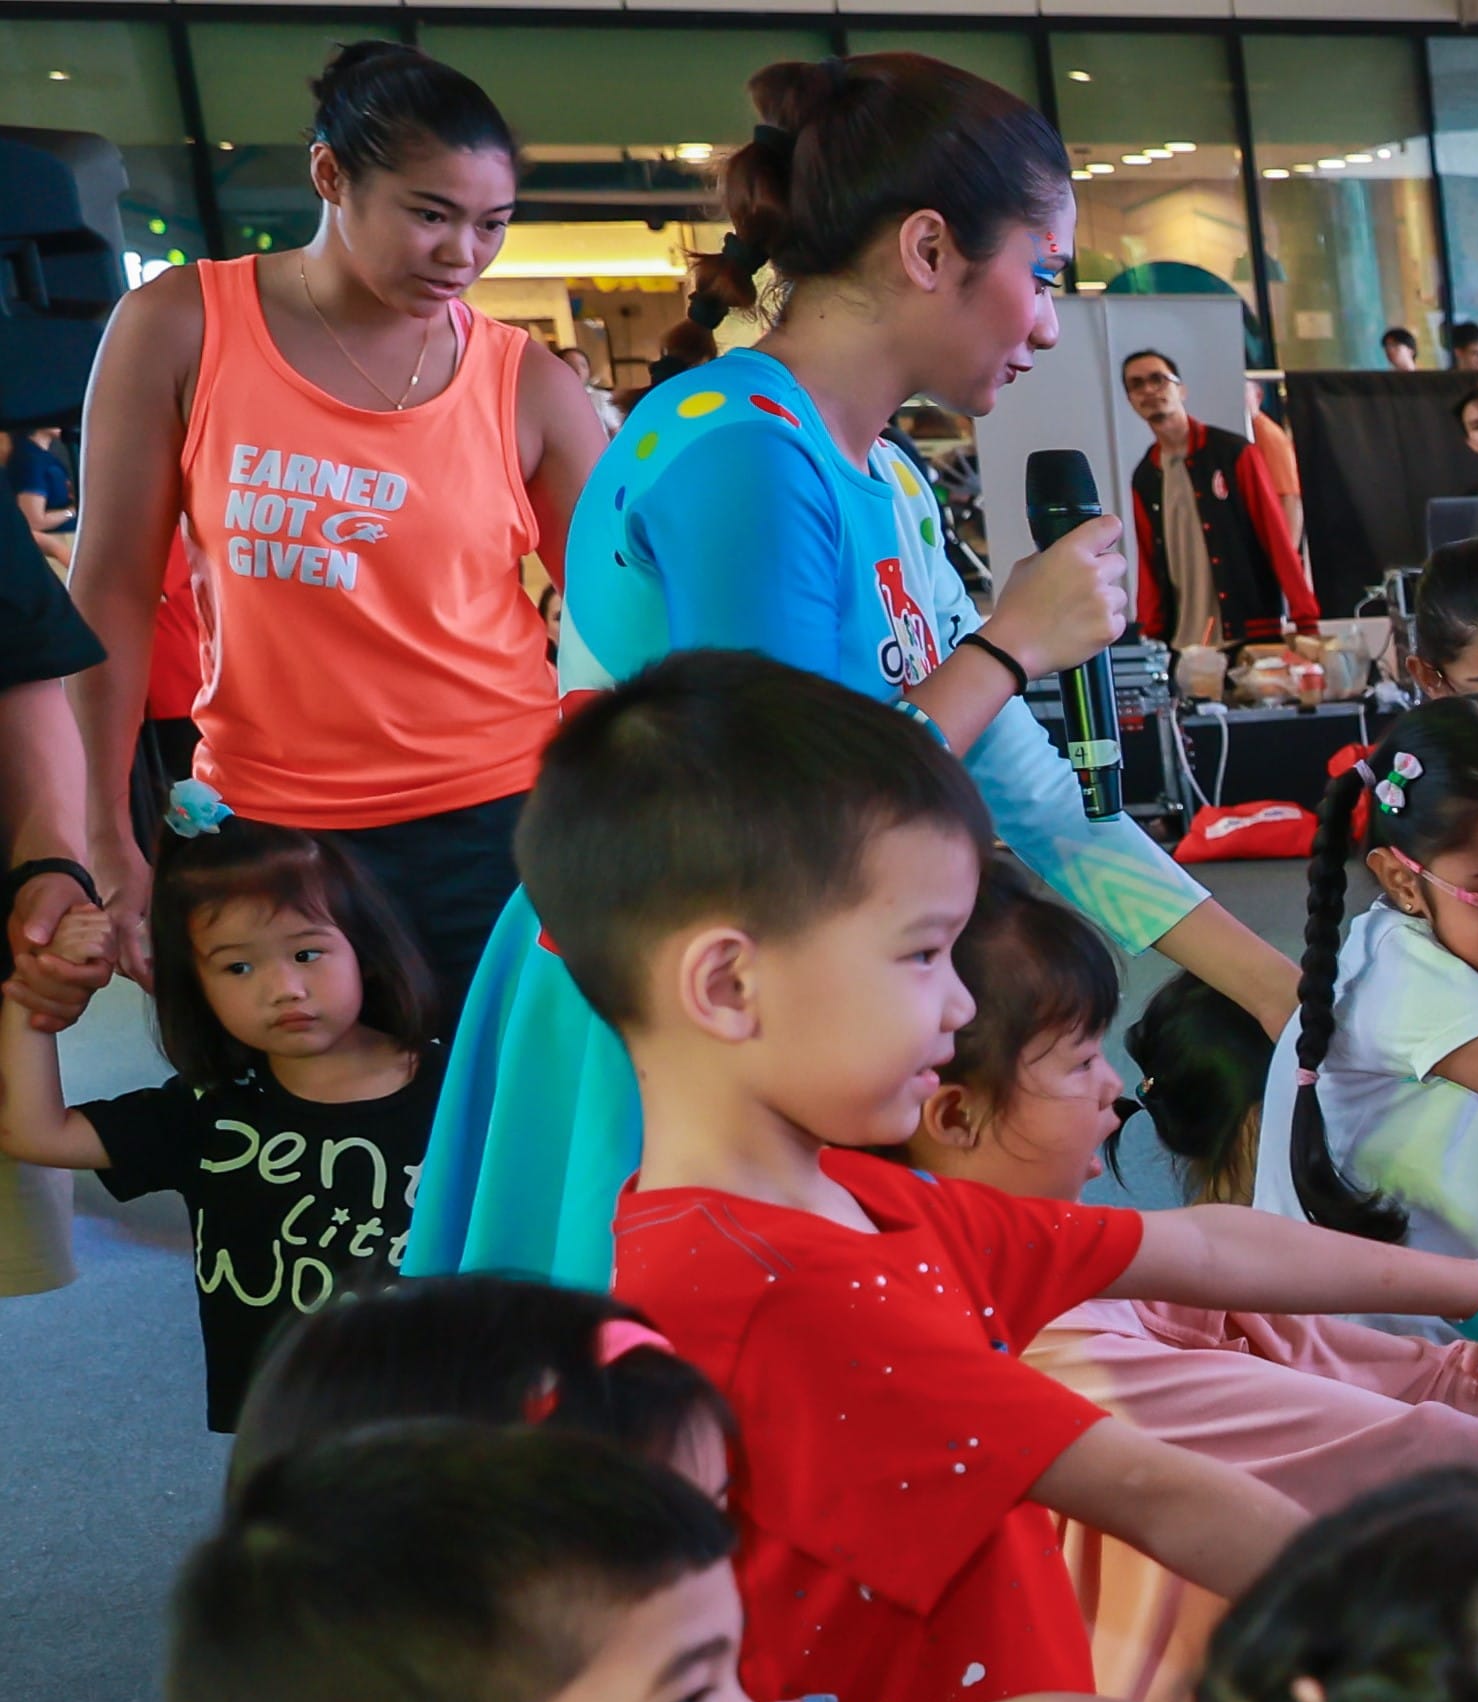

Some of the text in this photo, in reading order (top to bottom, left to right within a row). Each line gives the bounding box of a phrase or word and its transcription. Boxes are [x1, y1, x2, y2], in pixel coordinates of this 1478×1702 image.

[229, 443, 408, 512] EARNED
[224, 488, 317, 538] NOT
[227, 535, 359, 590] GIVEN
